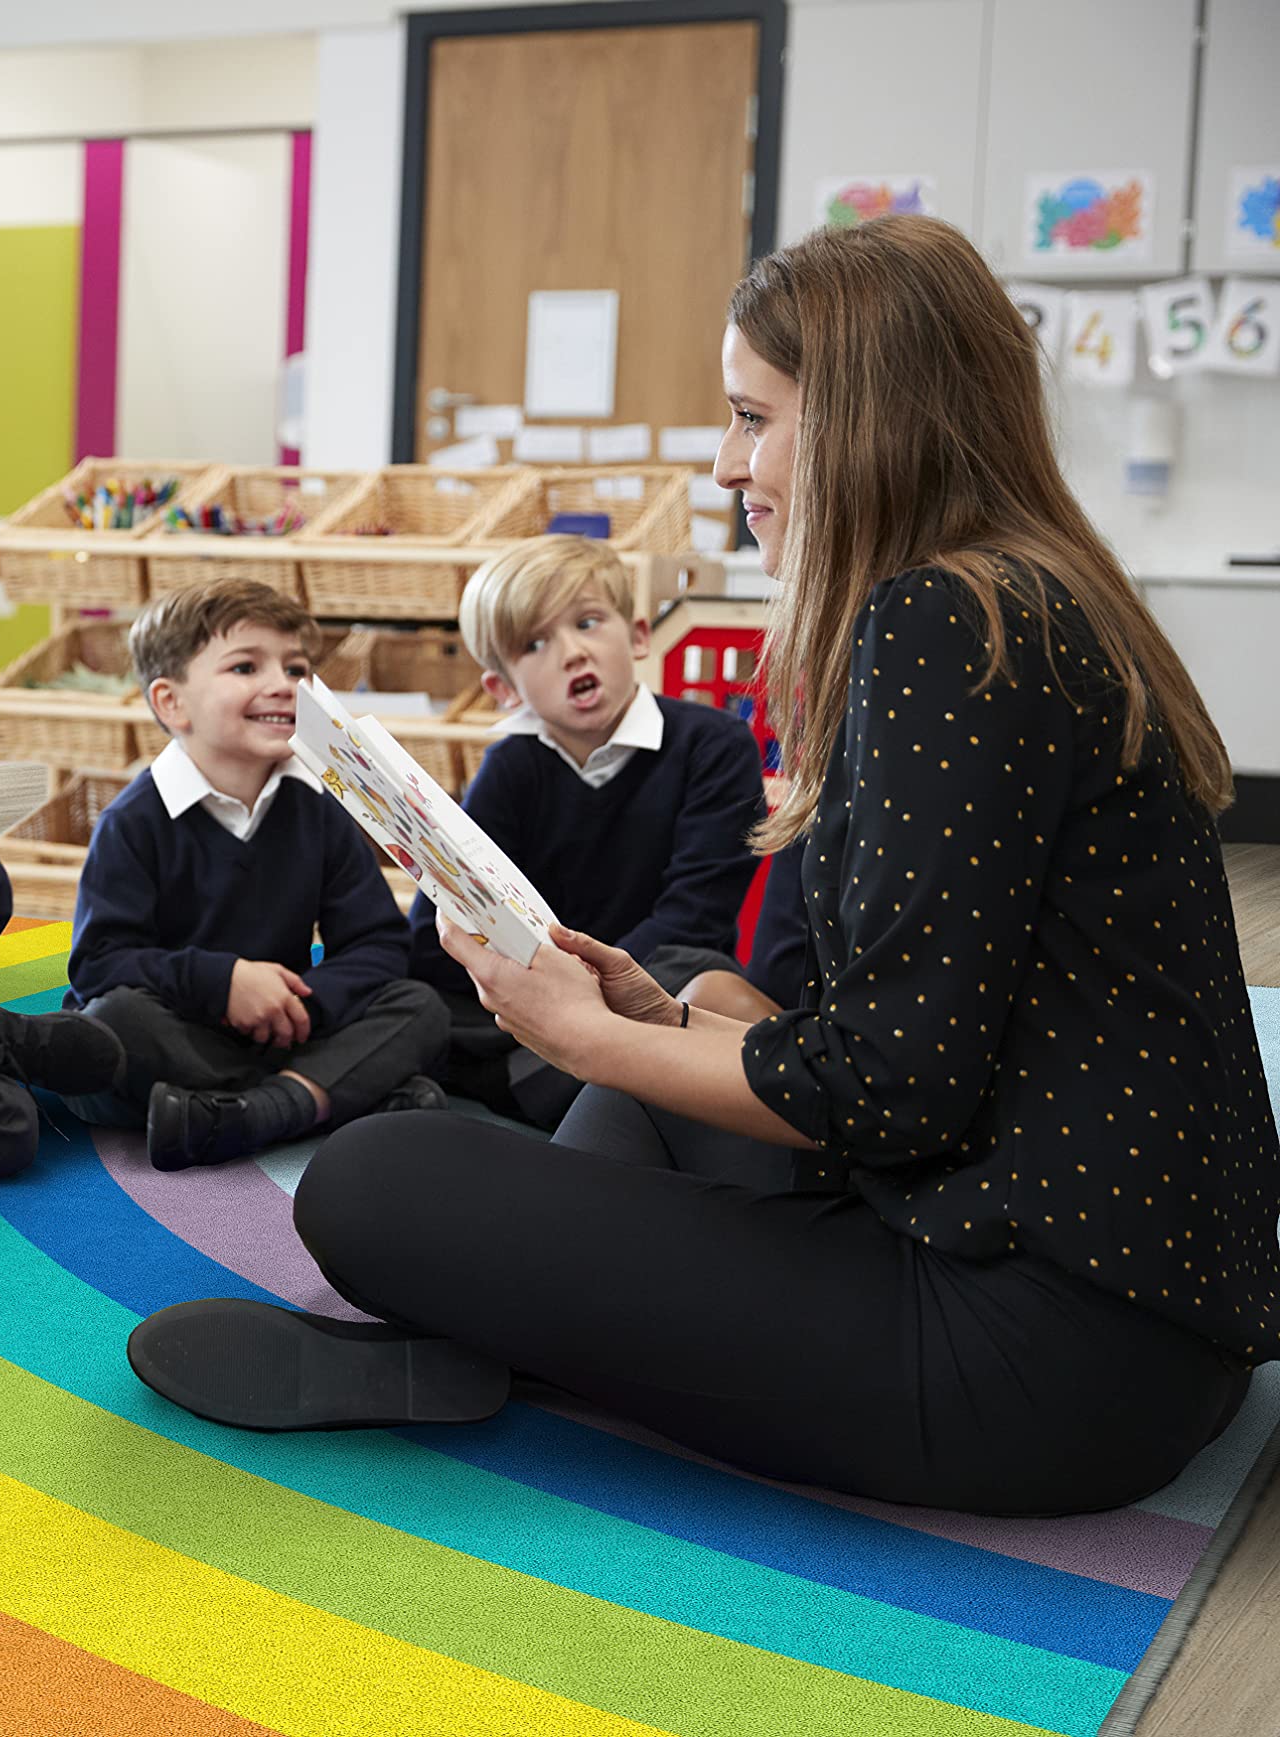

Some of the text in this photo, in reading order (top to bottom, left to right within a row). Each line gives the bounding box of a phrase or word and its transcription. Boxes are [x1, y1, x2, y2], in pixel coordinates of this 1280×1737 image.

[1074, 311, 1112, 368] 4
[1168, 296, 1205, 357] 5
[1227, 299, 1267, 359] 6
